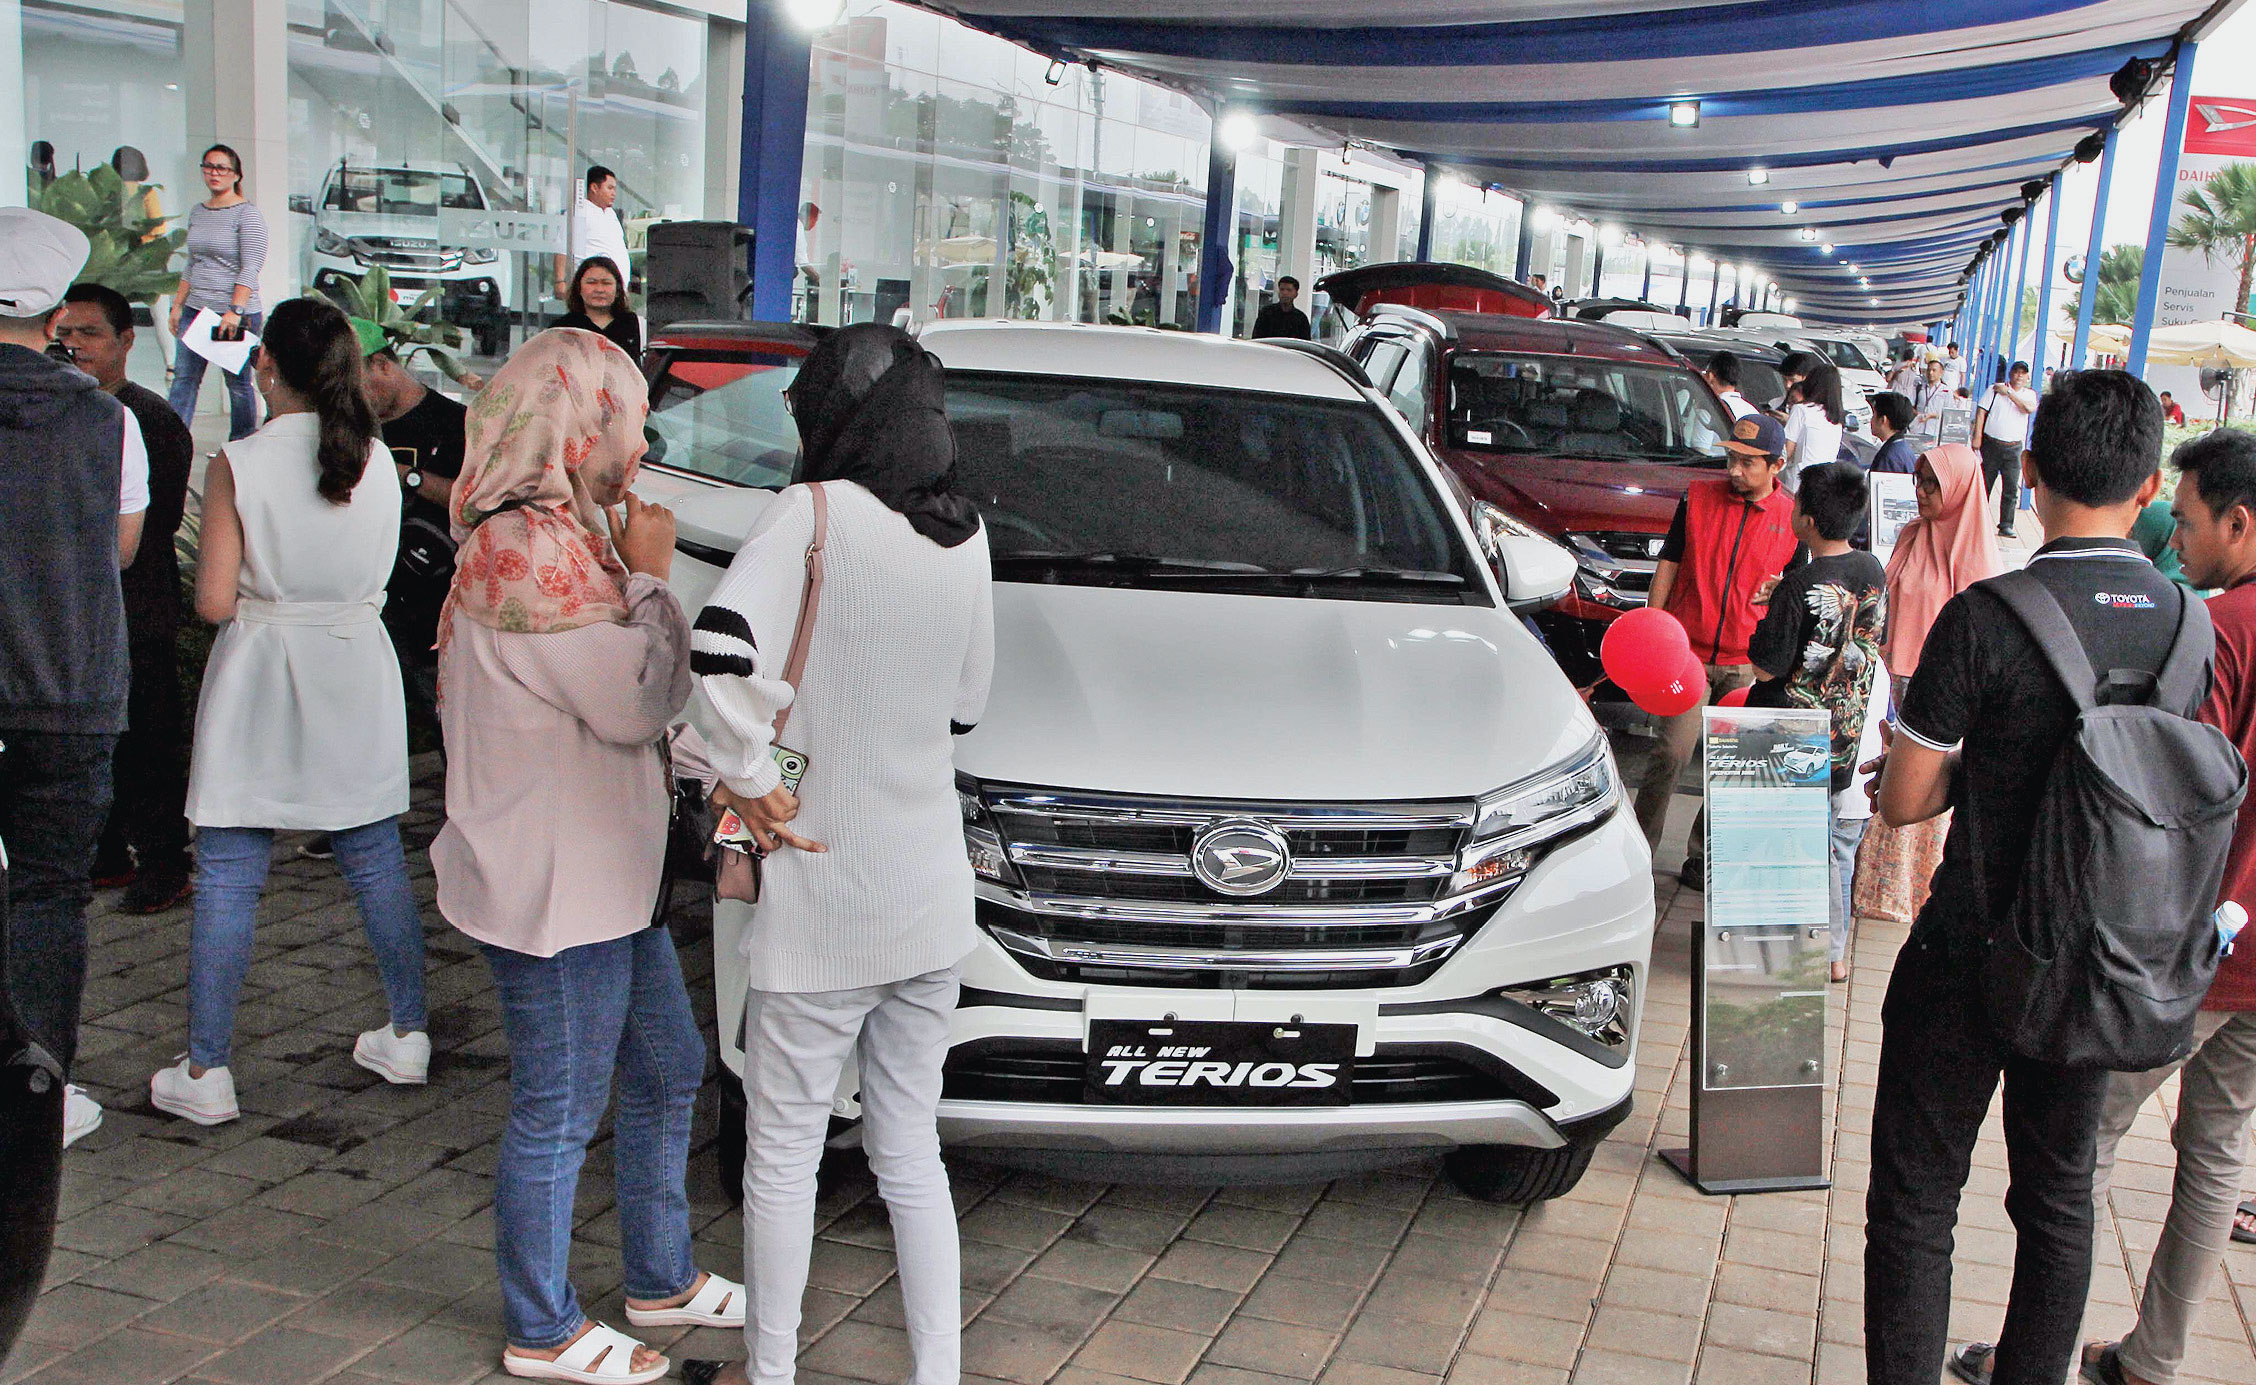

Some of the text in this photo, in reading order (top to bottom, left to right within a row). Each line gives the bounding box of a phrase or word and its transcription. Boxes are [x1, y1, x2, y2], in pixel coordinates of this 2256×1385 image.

[2165, 286, 2215, 298] Penjualan
[2163, 301, 2194, 312] Servis
[2111, 594, 2150, 603] TOYOTA
[1708, 759, 1768, 768] TERIOS
[1106, 1045, 1212, 1058] ALL NEW
[1101, 1060, 1340, 1088] TERIOS
